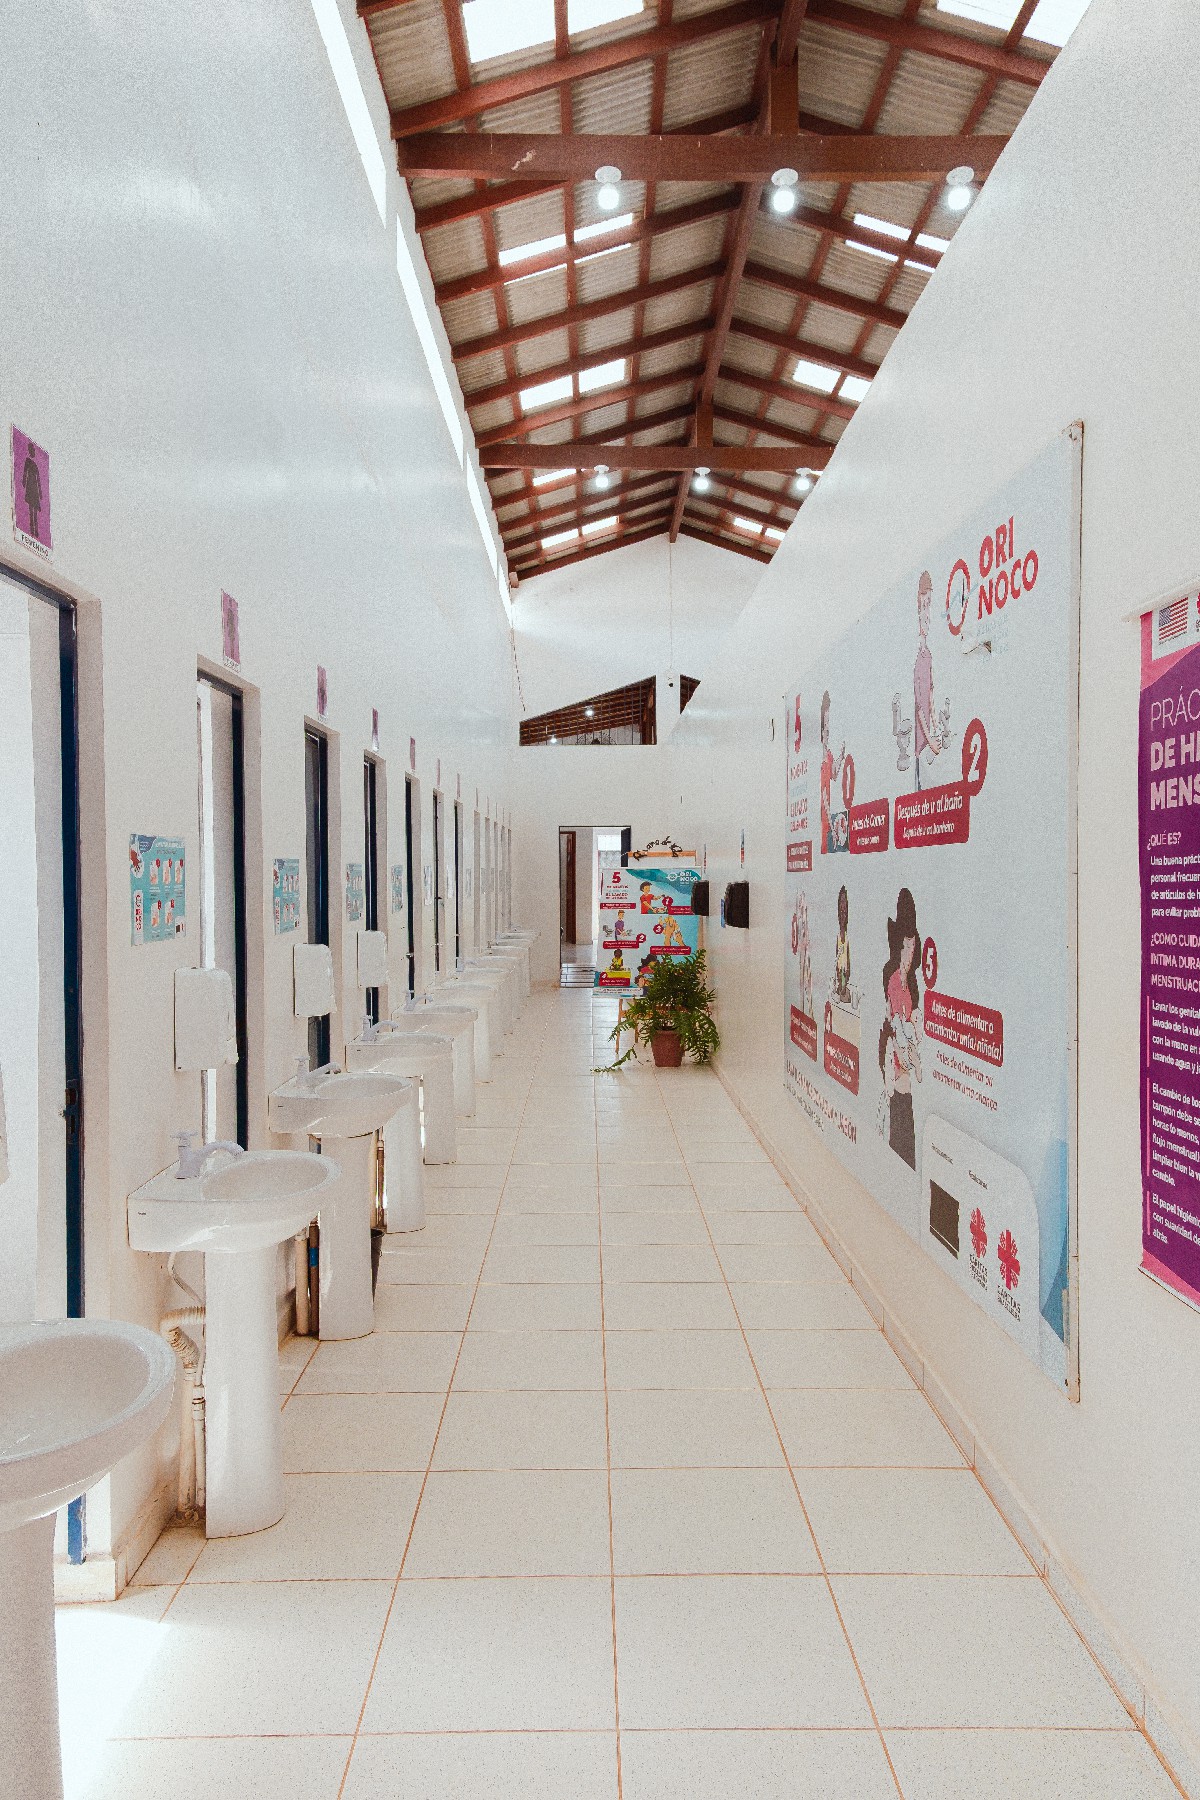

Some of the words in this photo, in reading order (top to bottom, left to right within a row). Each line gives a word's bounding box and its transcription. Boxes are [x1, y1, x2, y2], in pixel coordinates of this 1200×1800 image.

[979, 515, 1014, 578] ORI
[977, 549, 1039, 621] NOCO
[967, 732, 982, 783] 2
[1150, 737, 1176, 772] DE
[1150, 773, 1200, 811] MENS
[897, 801, 921, 823] Después
[921, 798, 930, 816] de
[931, 797, 936, 814] ir
[936, 794, 944, 812] al
[944, 790, 963, 812] baño
[1146, 829, 1167, 851] ¿QUÉ
[1167, 831, 1182, 846] ES?
[1150, 855, 1162, 866] Una
[1163, 855, 1183, 866] buena
[612, 871, 621, 884] 5
[1150, 871, 1177, 886] personal
[1151, 890, 1159, 900] de
[1186, 888, 1195, 900] de
[1151, 907, 1165, 919] para
[925, 947, 934, 980] 5
[1152, 999, 1168, 1013] Lavar
[1168, 1002, 1179, 1015] los
[947, 1005, 956, 1021] de
[956, 1009, 989, 1032] alimentar
[988, 1022, 994, 1035] o
[1152, 1016, 1172, 1031] lavado
[1172, 1021, 1182, 1033] de
[1182, 1022, 1189, 1035] la
[1152, 1035, 1164, 1045] con
[1164, 1035, 1171, 1047] la
[1171, 1039, 1189, 1052] mano
[1189, 1044, 1198, 1055] en
[1152, 1051, 1175, 1066] usando
[1174, 1058, 1191, 1071] agua
[1191, 1062, 1196, 1075] y
[1152, 1082, 1159, 1094] El
[1159, 1086, 1182, 1102] cambio
[1182, 1093, 1191, 1105] de
[1152, 1099, 1176, 1117] tampón
[1176, 1109, 1193, 1124] debe
[1152, 1116, 1170, 1132] horas
[1173, 1158, 1188, 1175] bien
[1188, 1165, 1195, 1178] la
[1152, 1192, 1159, 1205] El
[1159, 1198, 1177, 1215] papel
[1152, 1211, 1164, 1225] con
